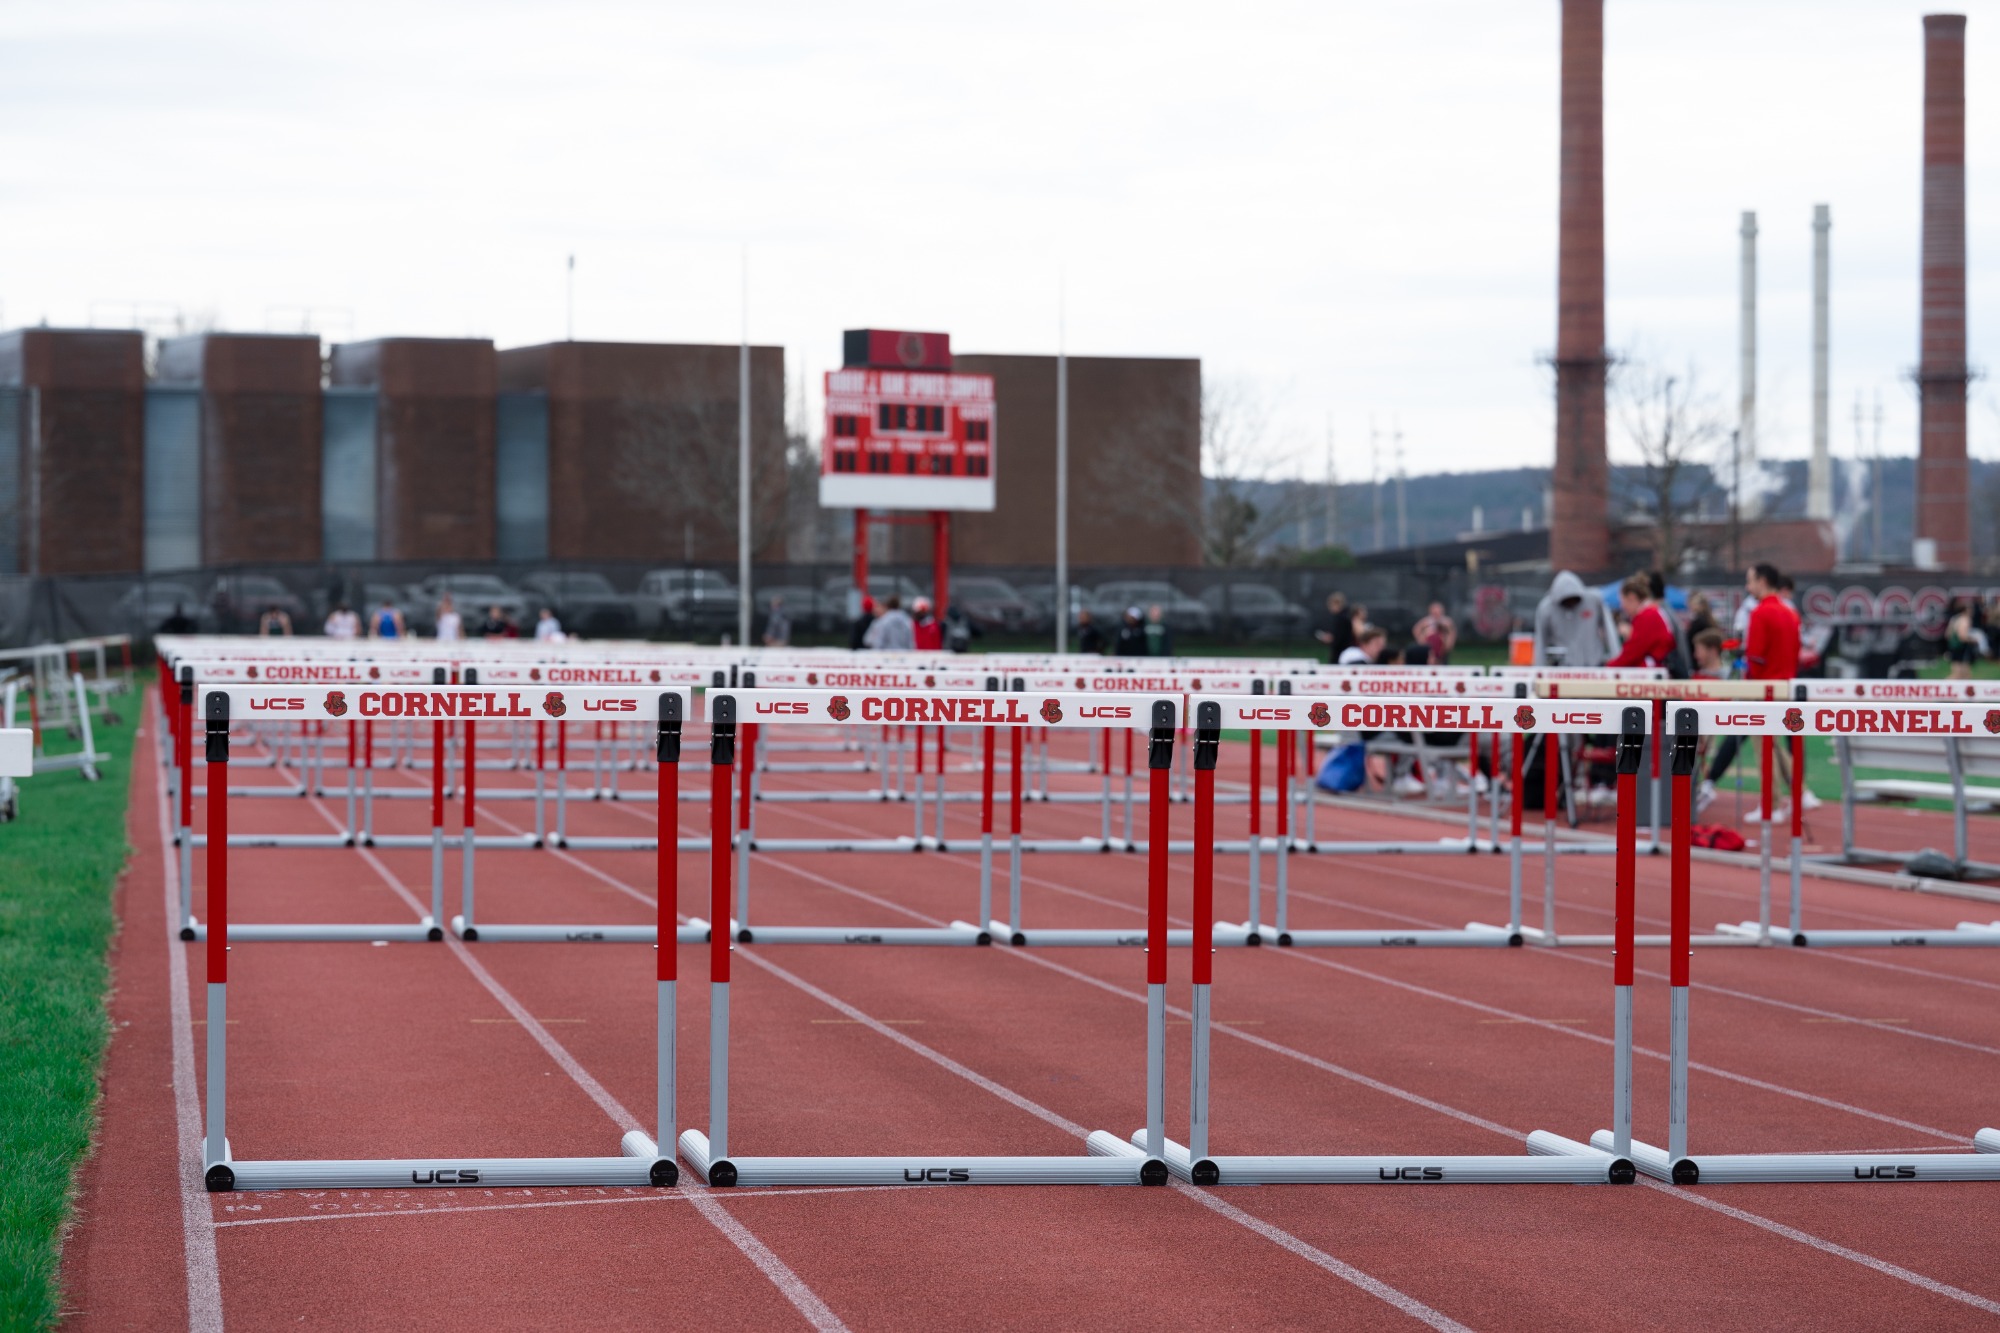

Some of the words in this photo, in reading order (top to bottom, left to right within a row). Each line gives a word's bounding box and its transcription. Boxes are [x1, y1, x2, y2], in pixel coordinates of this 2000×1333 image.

[265, 666, 361, 682] CORNELL
[547, 668, 642, 684] CORNELL
[824, 673, 918, 689] CORNELL
[1092, 677, 1186, 694] CORNELL
[1357, 680, 1449, 695] CORNELL
[1616, 683, 1708, 698] CORNELL
[1871, 685, 1958, 700] CORNELL
[250, 698, 305, 711] UCS
[358, 692, 532, 718] CORNELL
[583, 699, 638, 712] UCS
[755, 701, 809, 715] UCS
[861, 697, 1029, 724] CORNELL
[1079, 706, 1132, 719] UCS
[1239, 708, 1291, 721] UCS
[1342, 704, 1503, 729] CORNELL
[1551, 712, 1603, 725] UCS
[1715, 714, 1766, 726] UCS
[1815, 709, 1973, 733] CORNELL
[412, 1169, 480, 1184] UCS
[904, 1168, 970, 1182] UCS
[1380, 1167, 1443, 1180] UCS
[1854, 1165, 1916, 1179] UCS
